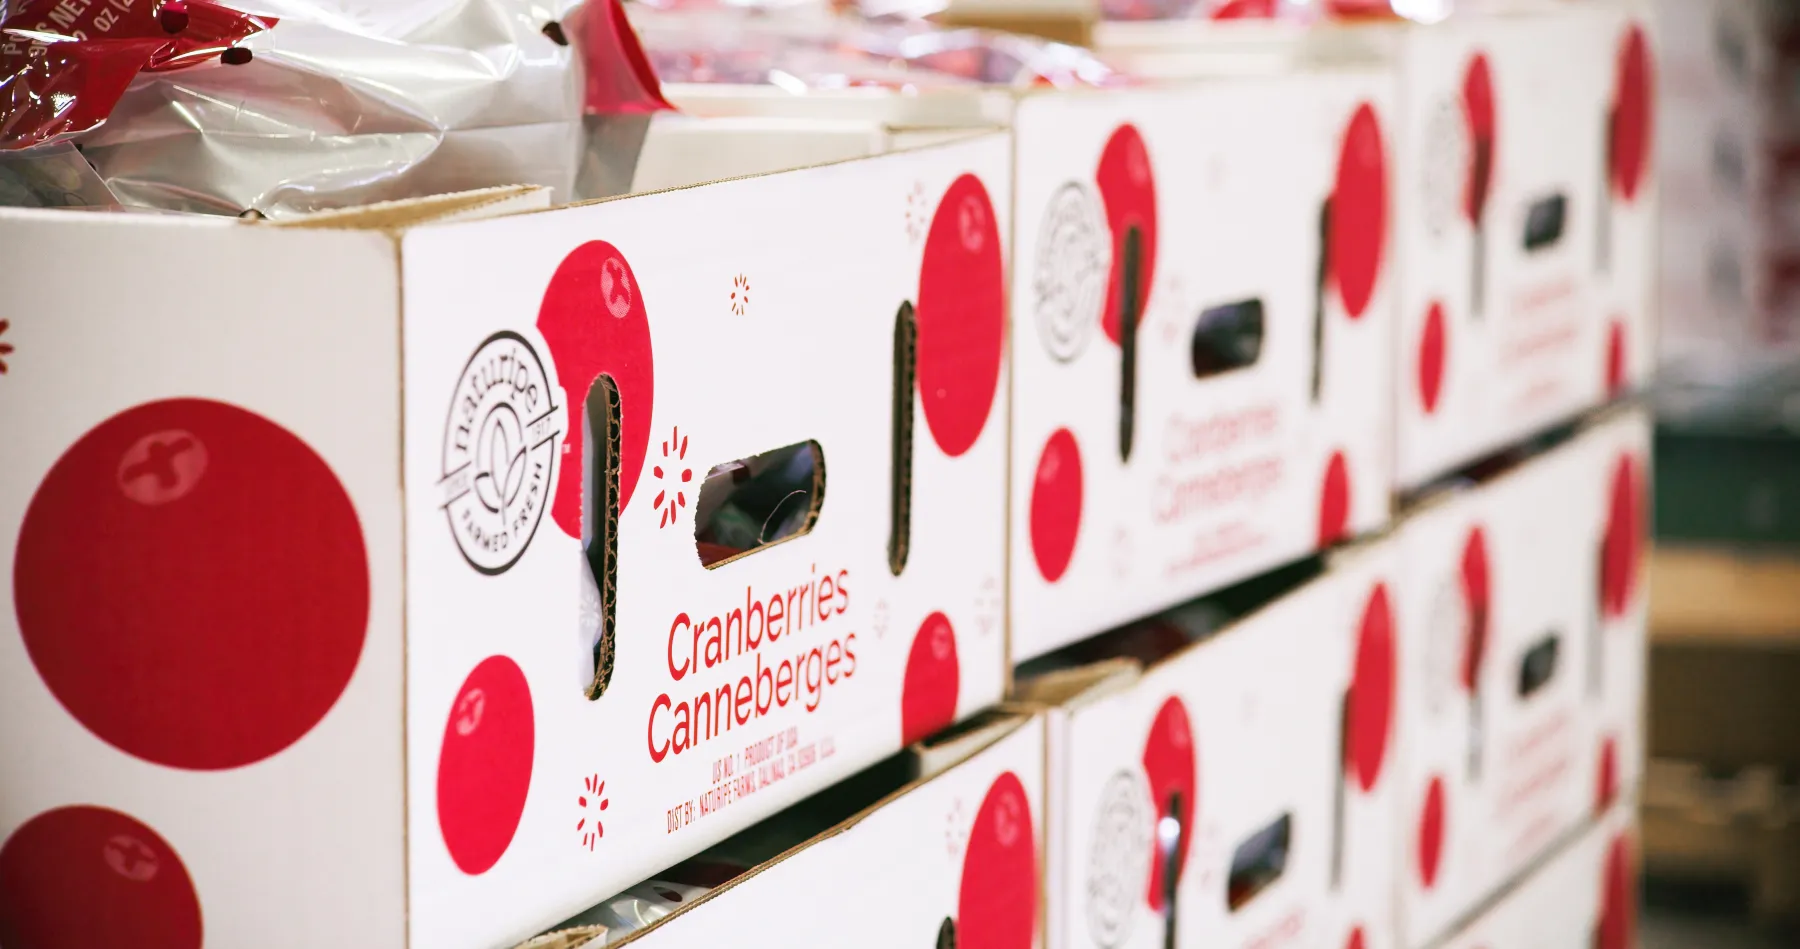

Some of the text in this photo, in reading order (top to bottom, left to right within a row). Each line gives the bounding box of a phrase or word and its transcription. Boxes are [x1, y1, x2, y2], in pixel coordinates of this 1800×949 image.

[48, 0, 92, 29] NE
[93, 7, 120, 32] OZ
[455, 347, 538, 452] naturipe
[513, 463, 542, 538] FRESH
[462, 509, 508, 552] FARMED
[667, 562, 849, 681] Cranberries
[647, 632, 856, 763] Canneberges
[712, 759, 722, 784] US
[744, 735, 774, 768] PRODUCT
[667, 804, 683, 834] DIST
[685, 799, 696, 825] BY:
[699, 781, 732, 818] NATURIPE
